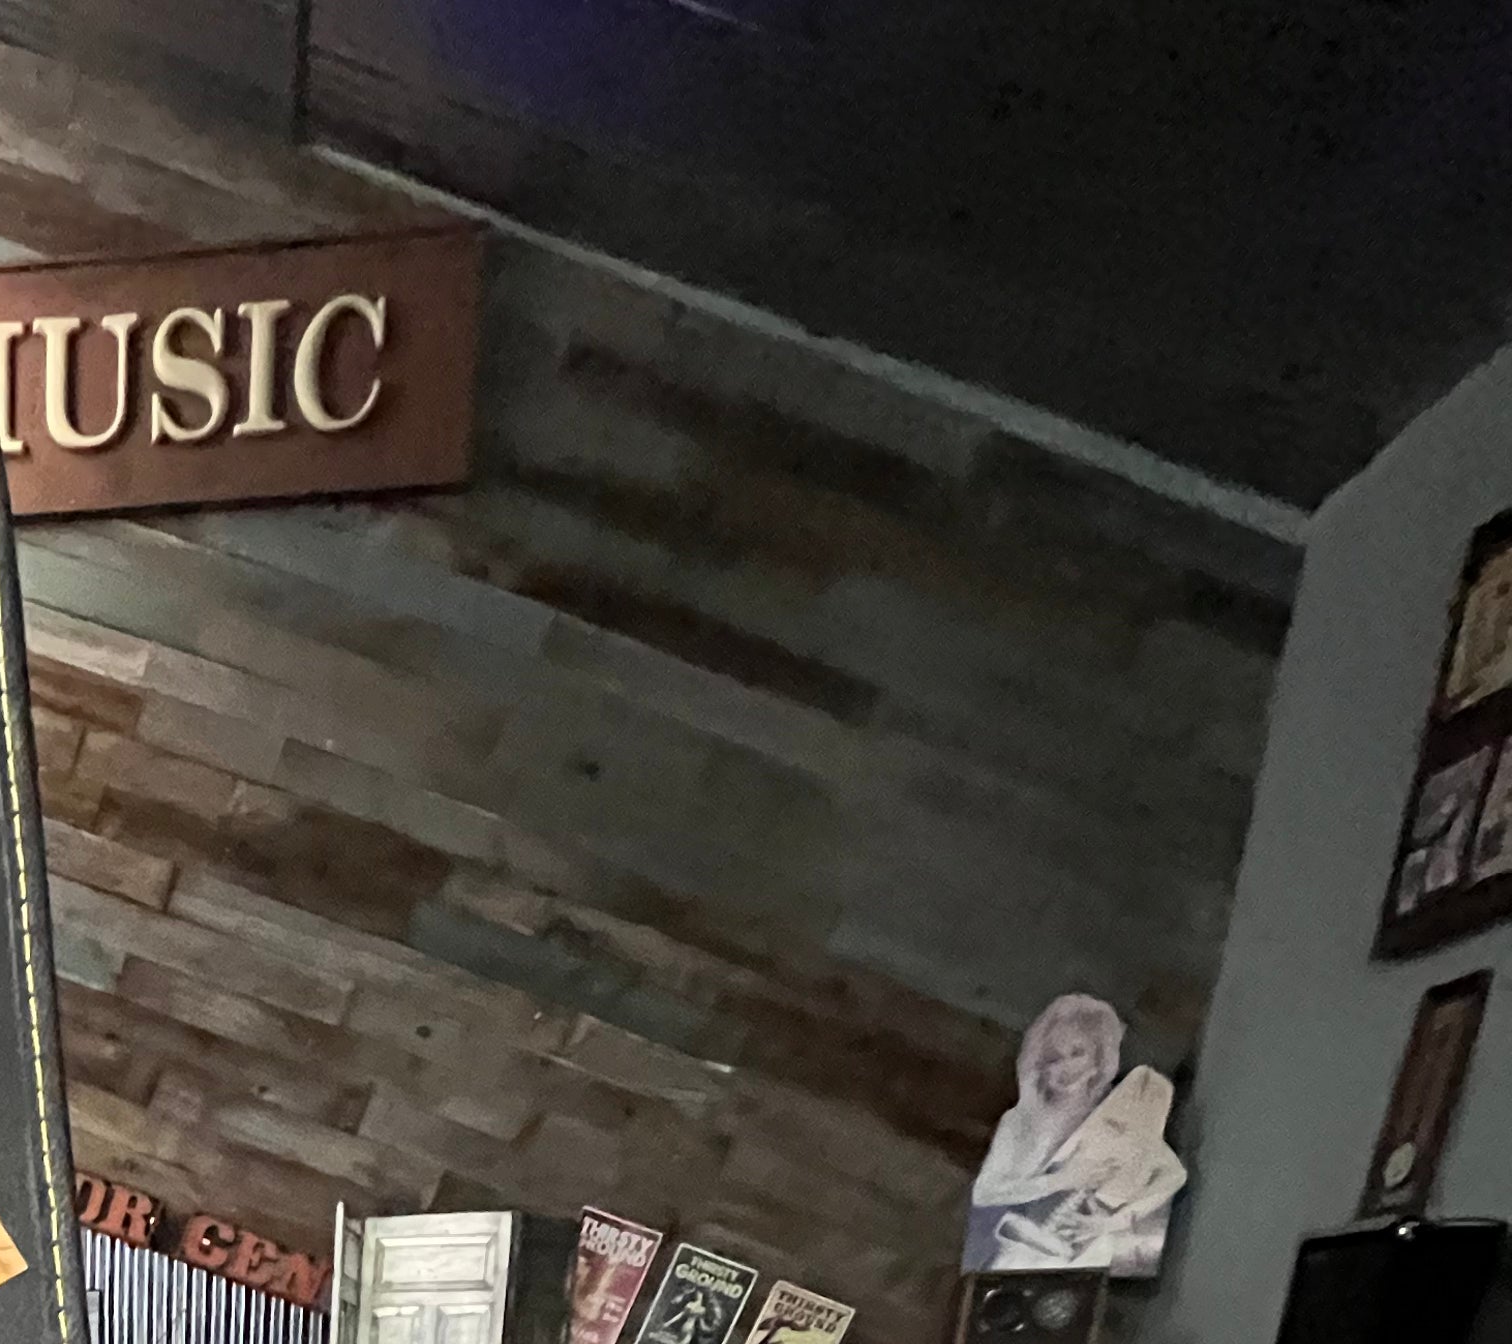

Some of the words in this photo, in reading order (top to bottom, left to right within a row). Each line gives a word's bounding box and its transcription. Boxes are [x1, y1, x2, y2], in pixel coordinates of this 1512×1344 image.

[581, 1216, 654, 1253] THIRSTY
[579, 1237, 646, 1268] ROUND
[674, 1263, 744, 1300] GROUND
[690, 1255, 739, 1283] THIRSTY
[775, 1303, 836, 1334] GROUND
[778, 1290, 845, 1322] THIRSTY
